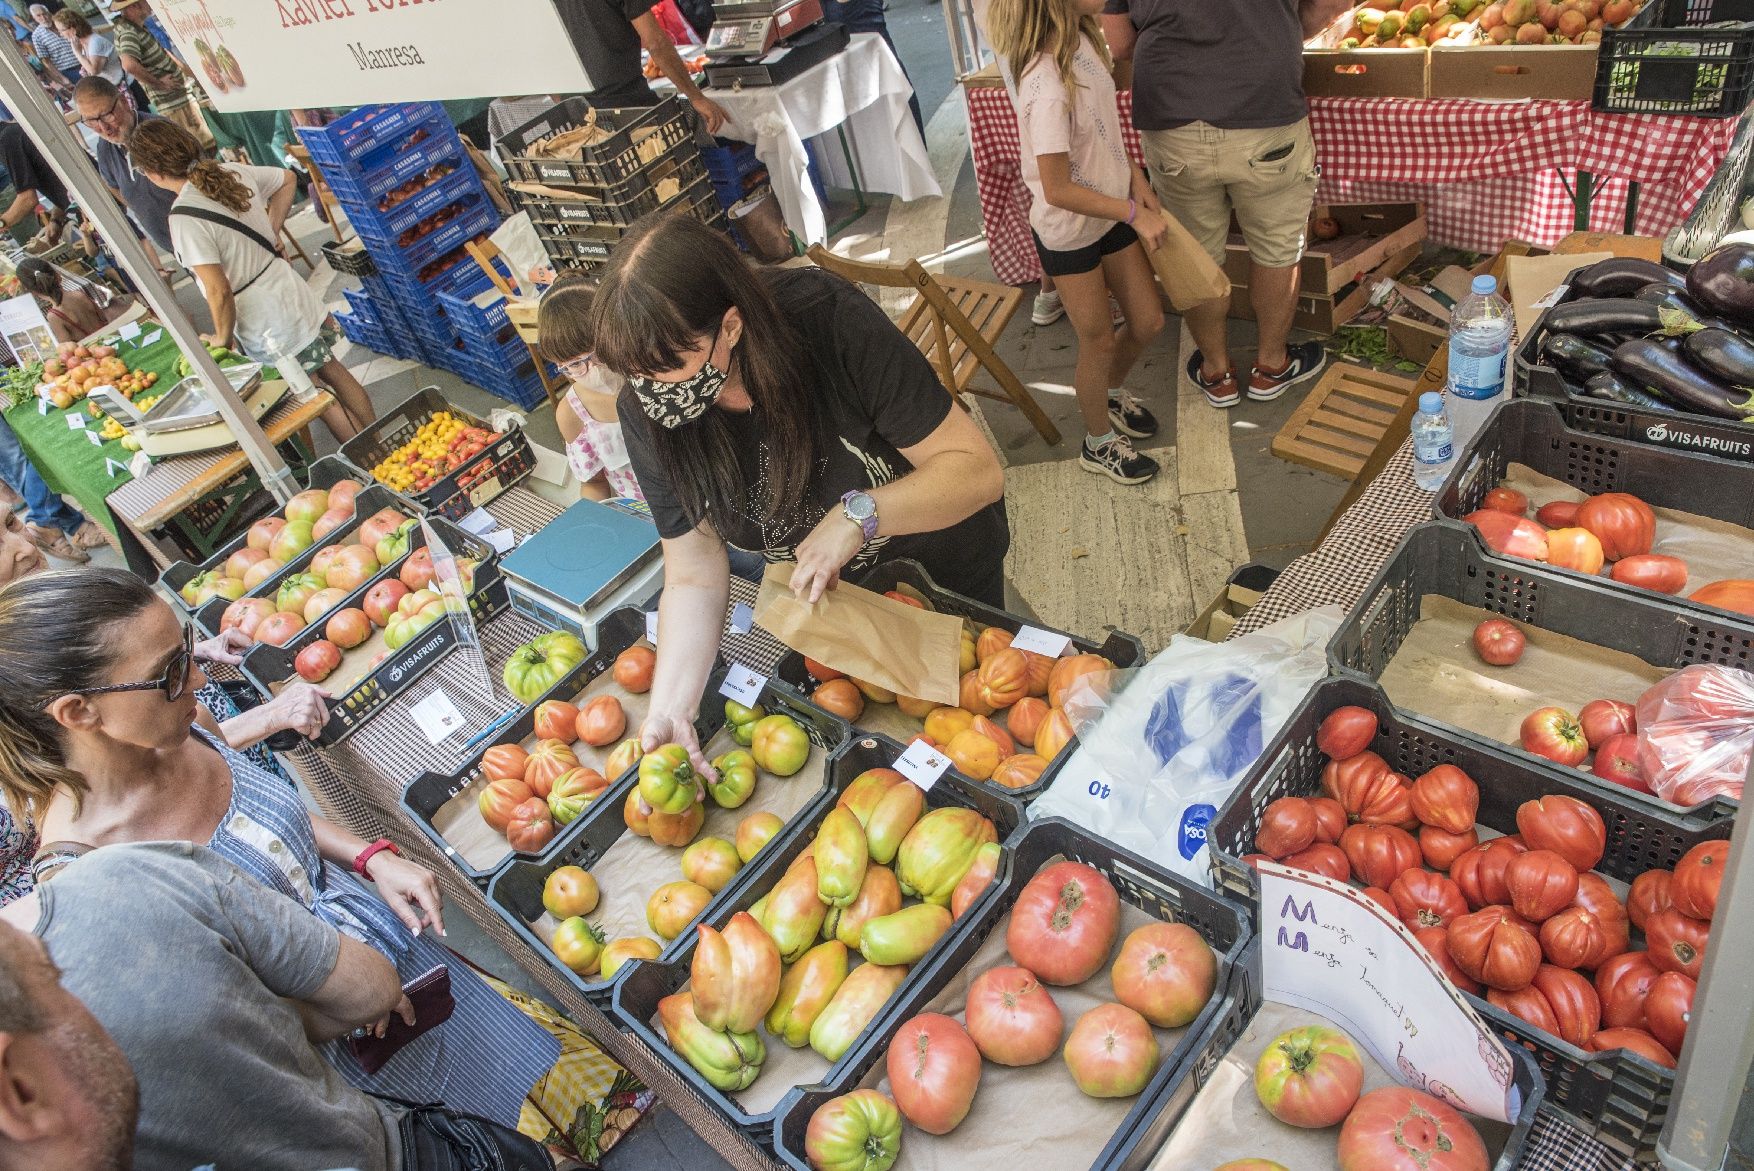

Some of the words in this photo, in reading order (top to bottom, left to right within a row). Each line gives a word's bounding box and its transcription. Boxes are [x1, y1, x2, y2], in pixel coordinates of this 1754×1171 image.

[346, 41, 425, 71] Manresa
[1668, 430, 1751, 455] VISAFRUITS
[399, 634, 445, 672] VISAFRUITS
[1088, 779, 1111, 800] 40
